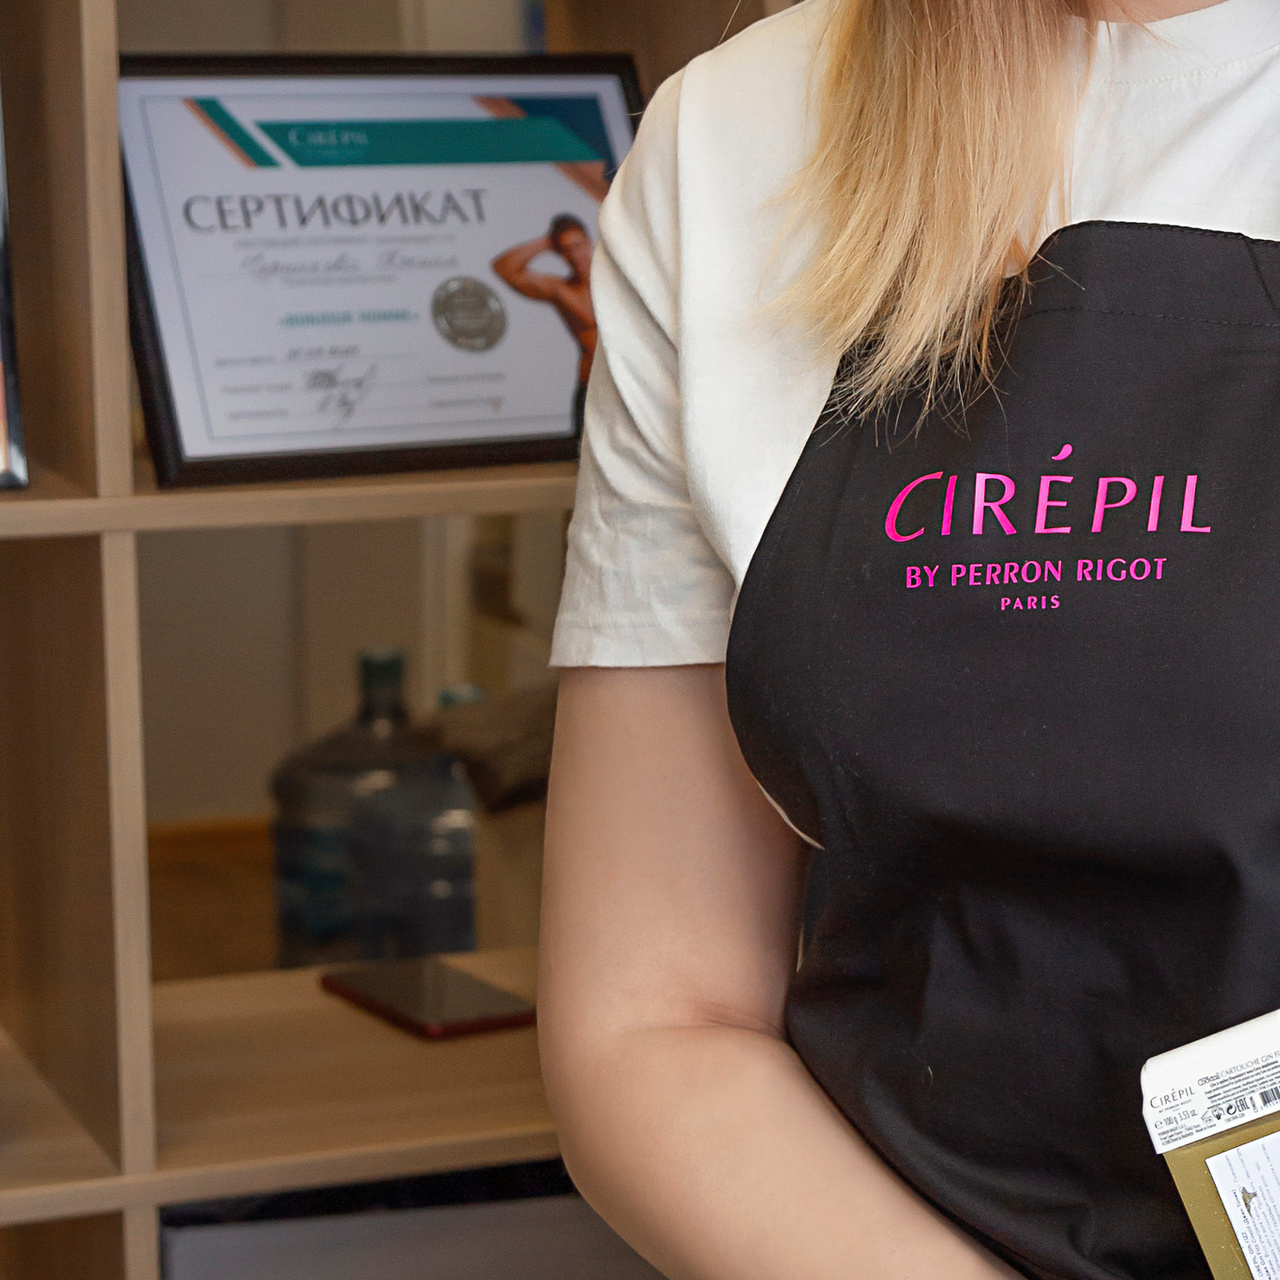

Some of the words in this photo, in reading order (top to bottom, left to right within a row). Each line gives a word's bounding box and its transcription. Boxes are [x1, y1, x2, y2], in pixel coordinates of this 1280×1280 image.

[182, 187, 488, 234] СЕРТИФИКАТ
[884, 443, 1212, 543] CIRÉPIL
[905, 564, 940, 589] BY
[951, 559, 1063, 587] PERRON
[1076, 557, 1168, 582] RIGOT
[1000, 594, 1061, 611] PARIS
[1221, 1058, 1260, 1077] CARTOUCHE
[1261, 1054, 1274, 1063] GIN
[1150, 1087, 1195, 1109] CIRÉPIL
[1163, 1116, 1174, 1126] 100
[1178, 1110, 1190, 1121] 3.53
